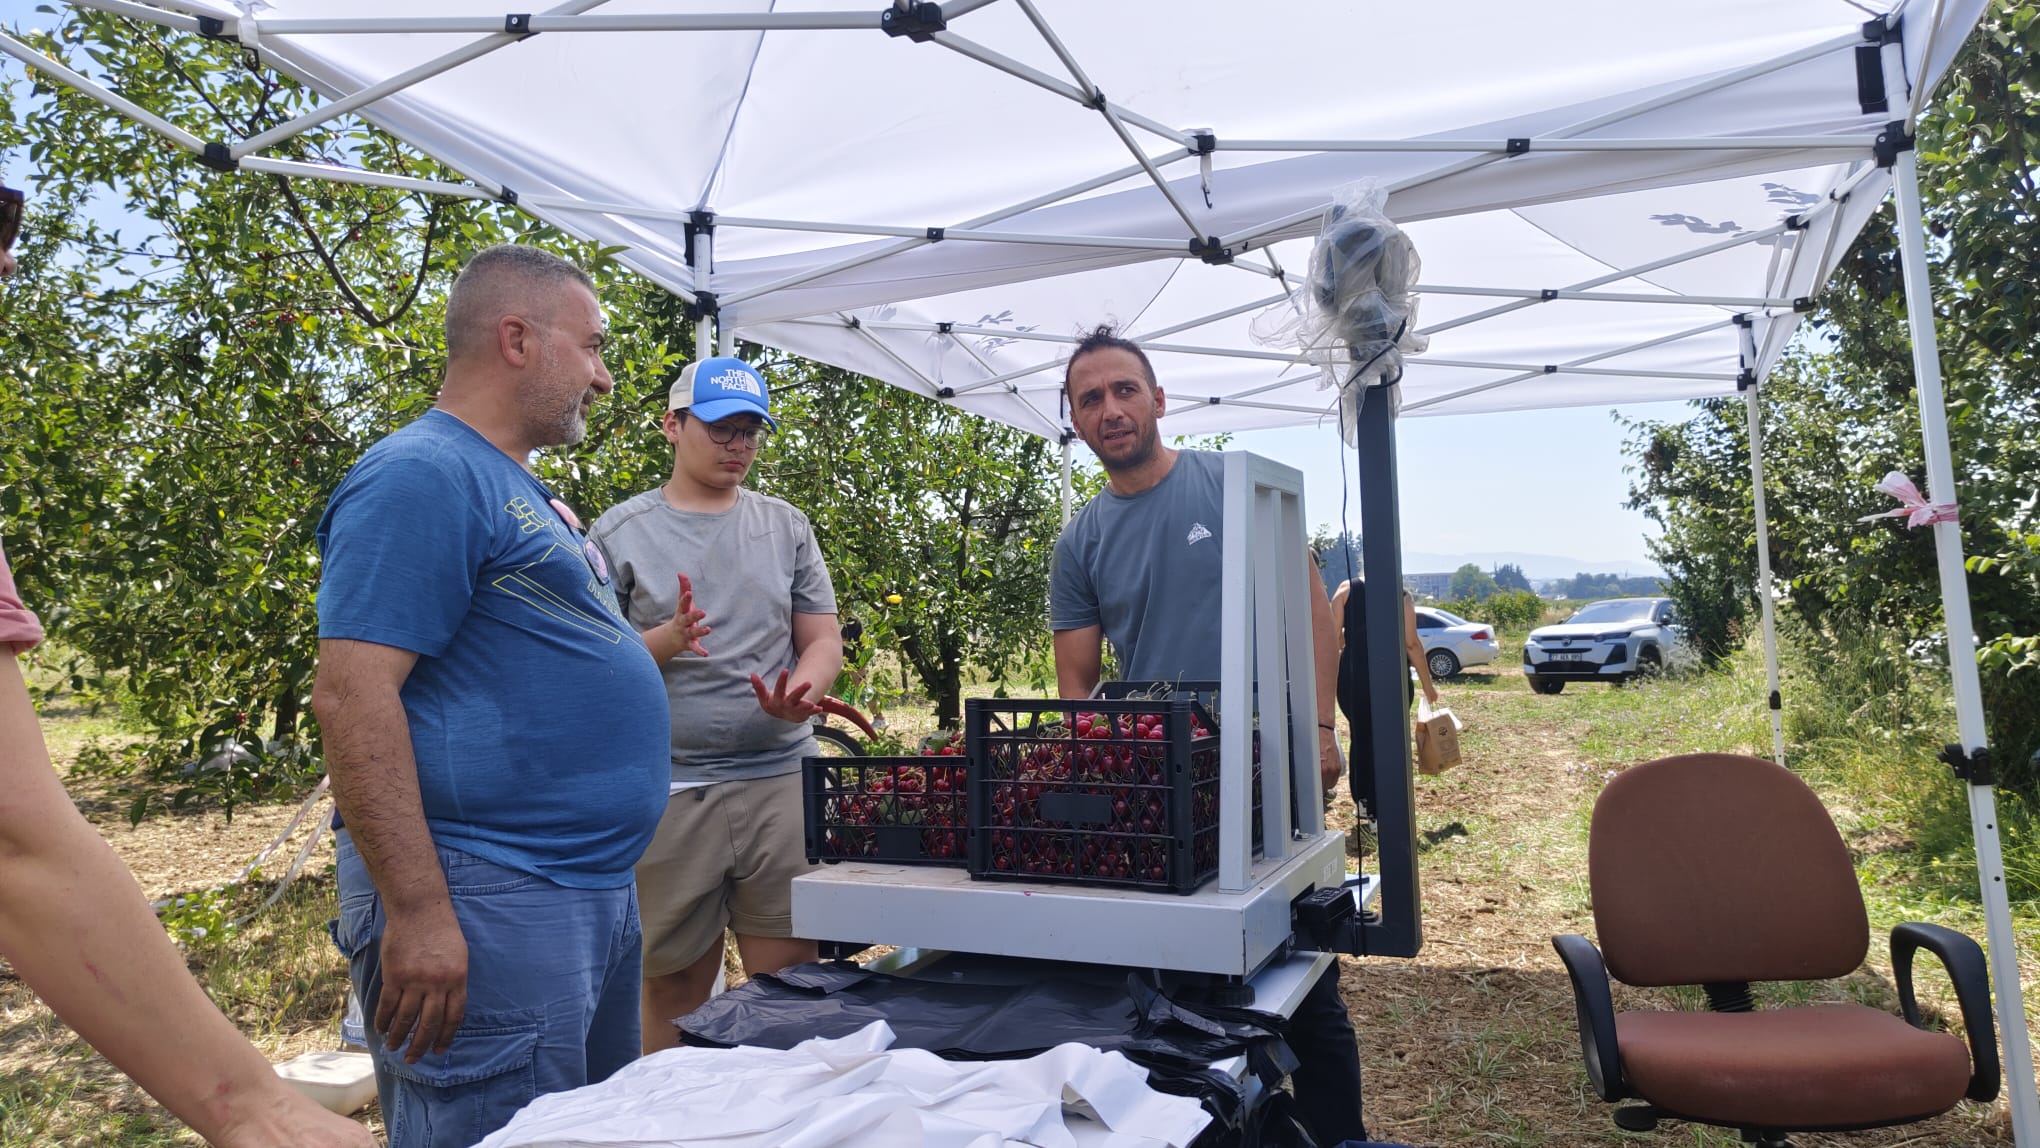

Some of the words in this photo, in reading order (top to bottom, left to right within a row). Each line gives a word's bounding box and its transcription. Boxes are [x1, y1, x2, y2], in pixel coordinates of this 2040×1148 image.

[725, 369, 745, 377] THE
[710, 376, 746, 384] NORTH
[722, 383, 748, 391] FACE
